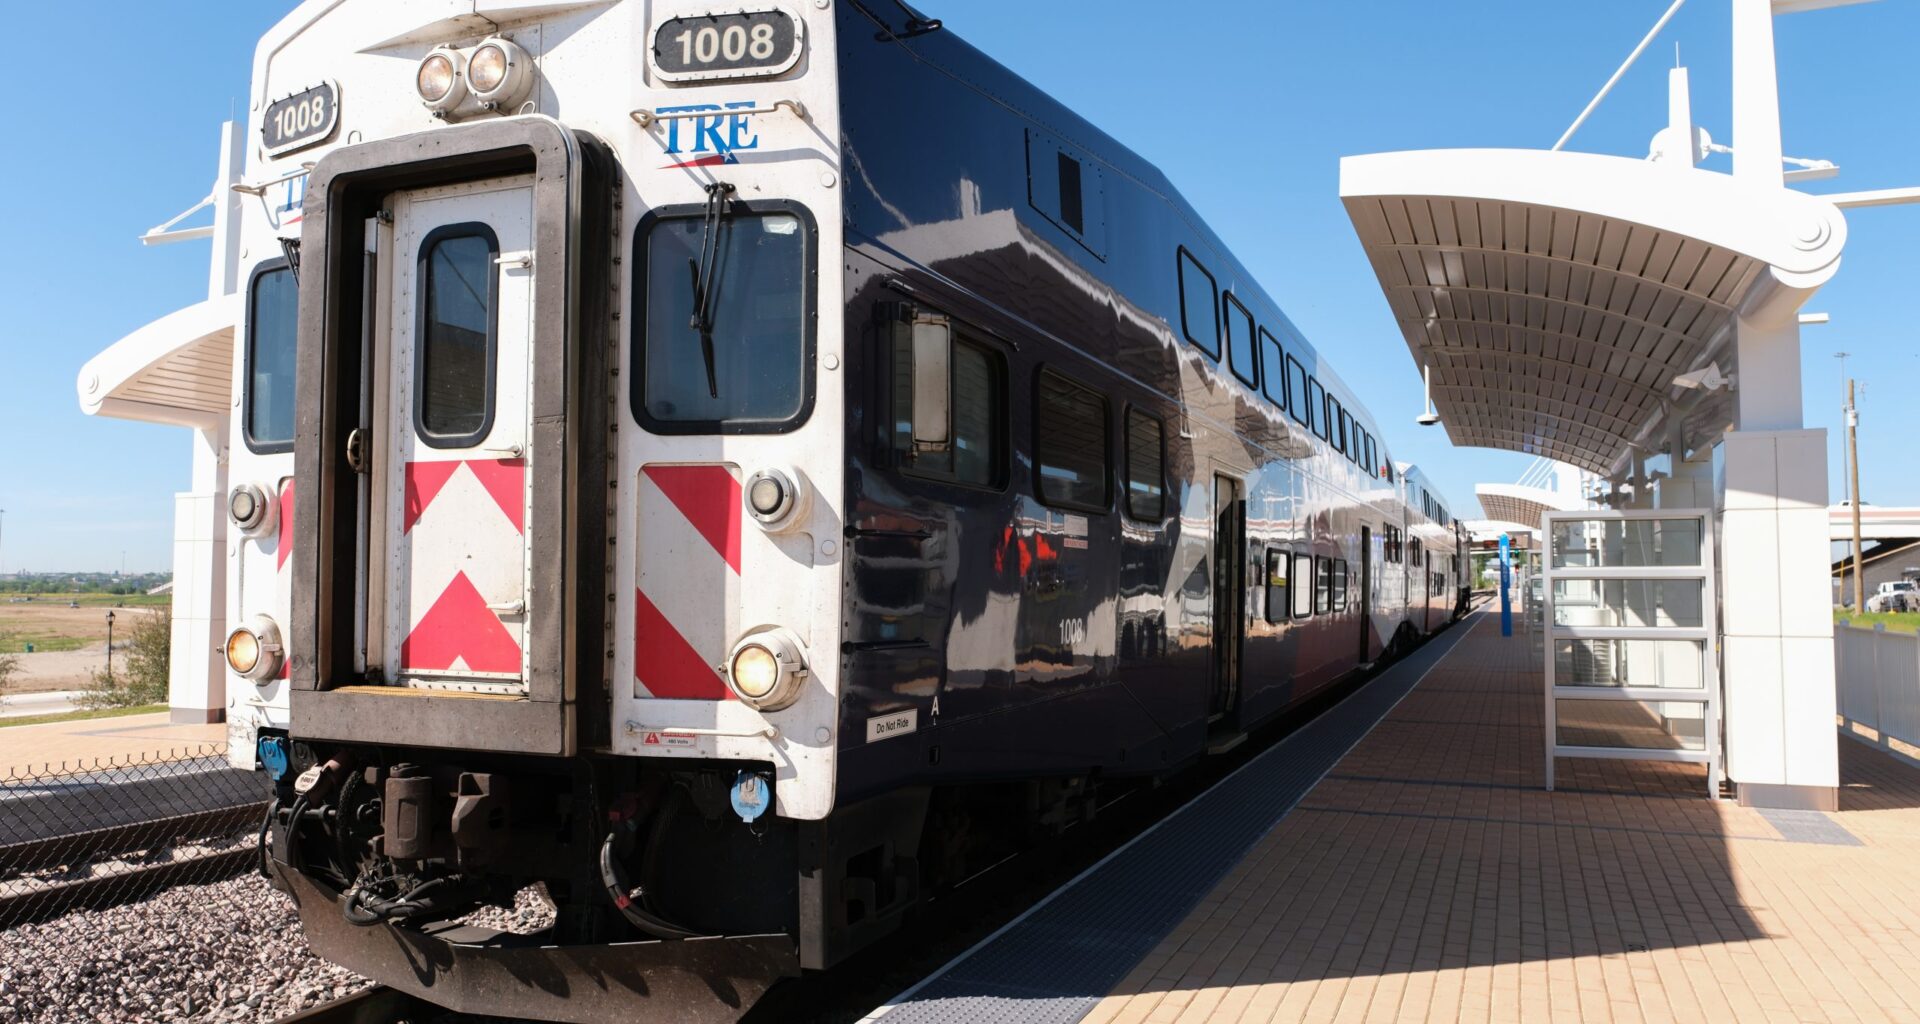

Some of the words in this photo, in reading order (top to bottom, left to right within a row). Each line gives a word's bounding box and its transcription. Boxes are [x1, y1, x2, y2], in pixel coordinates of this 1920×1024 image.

[675, 23, 775, 65] 1008
[274, 95, 325, 141] 1008
[655, 101, 758, 155] TRE
[1059, 617, 1083, 645] 1008
[930, 695, 940, 716] A
[876, 723, 885, 734] Do
[885, 720, 896, 731] Not
[896, 717, 909, 729] Ride
